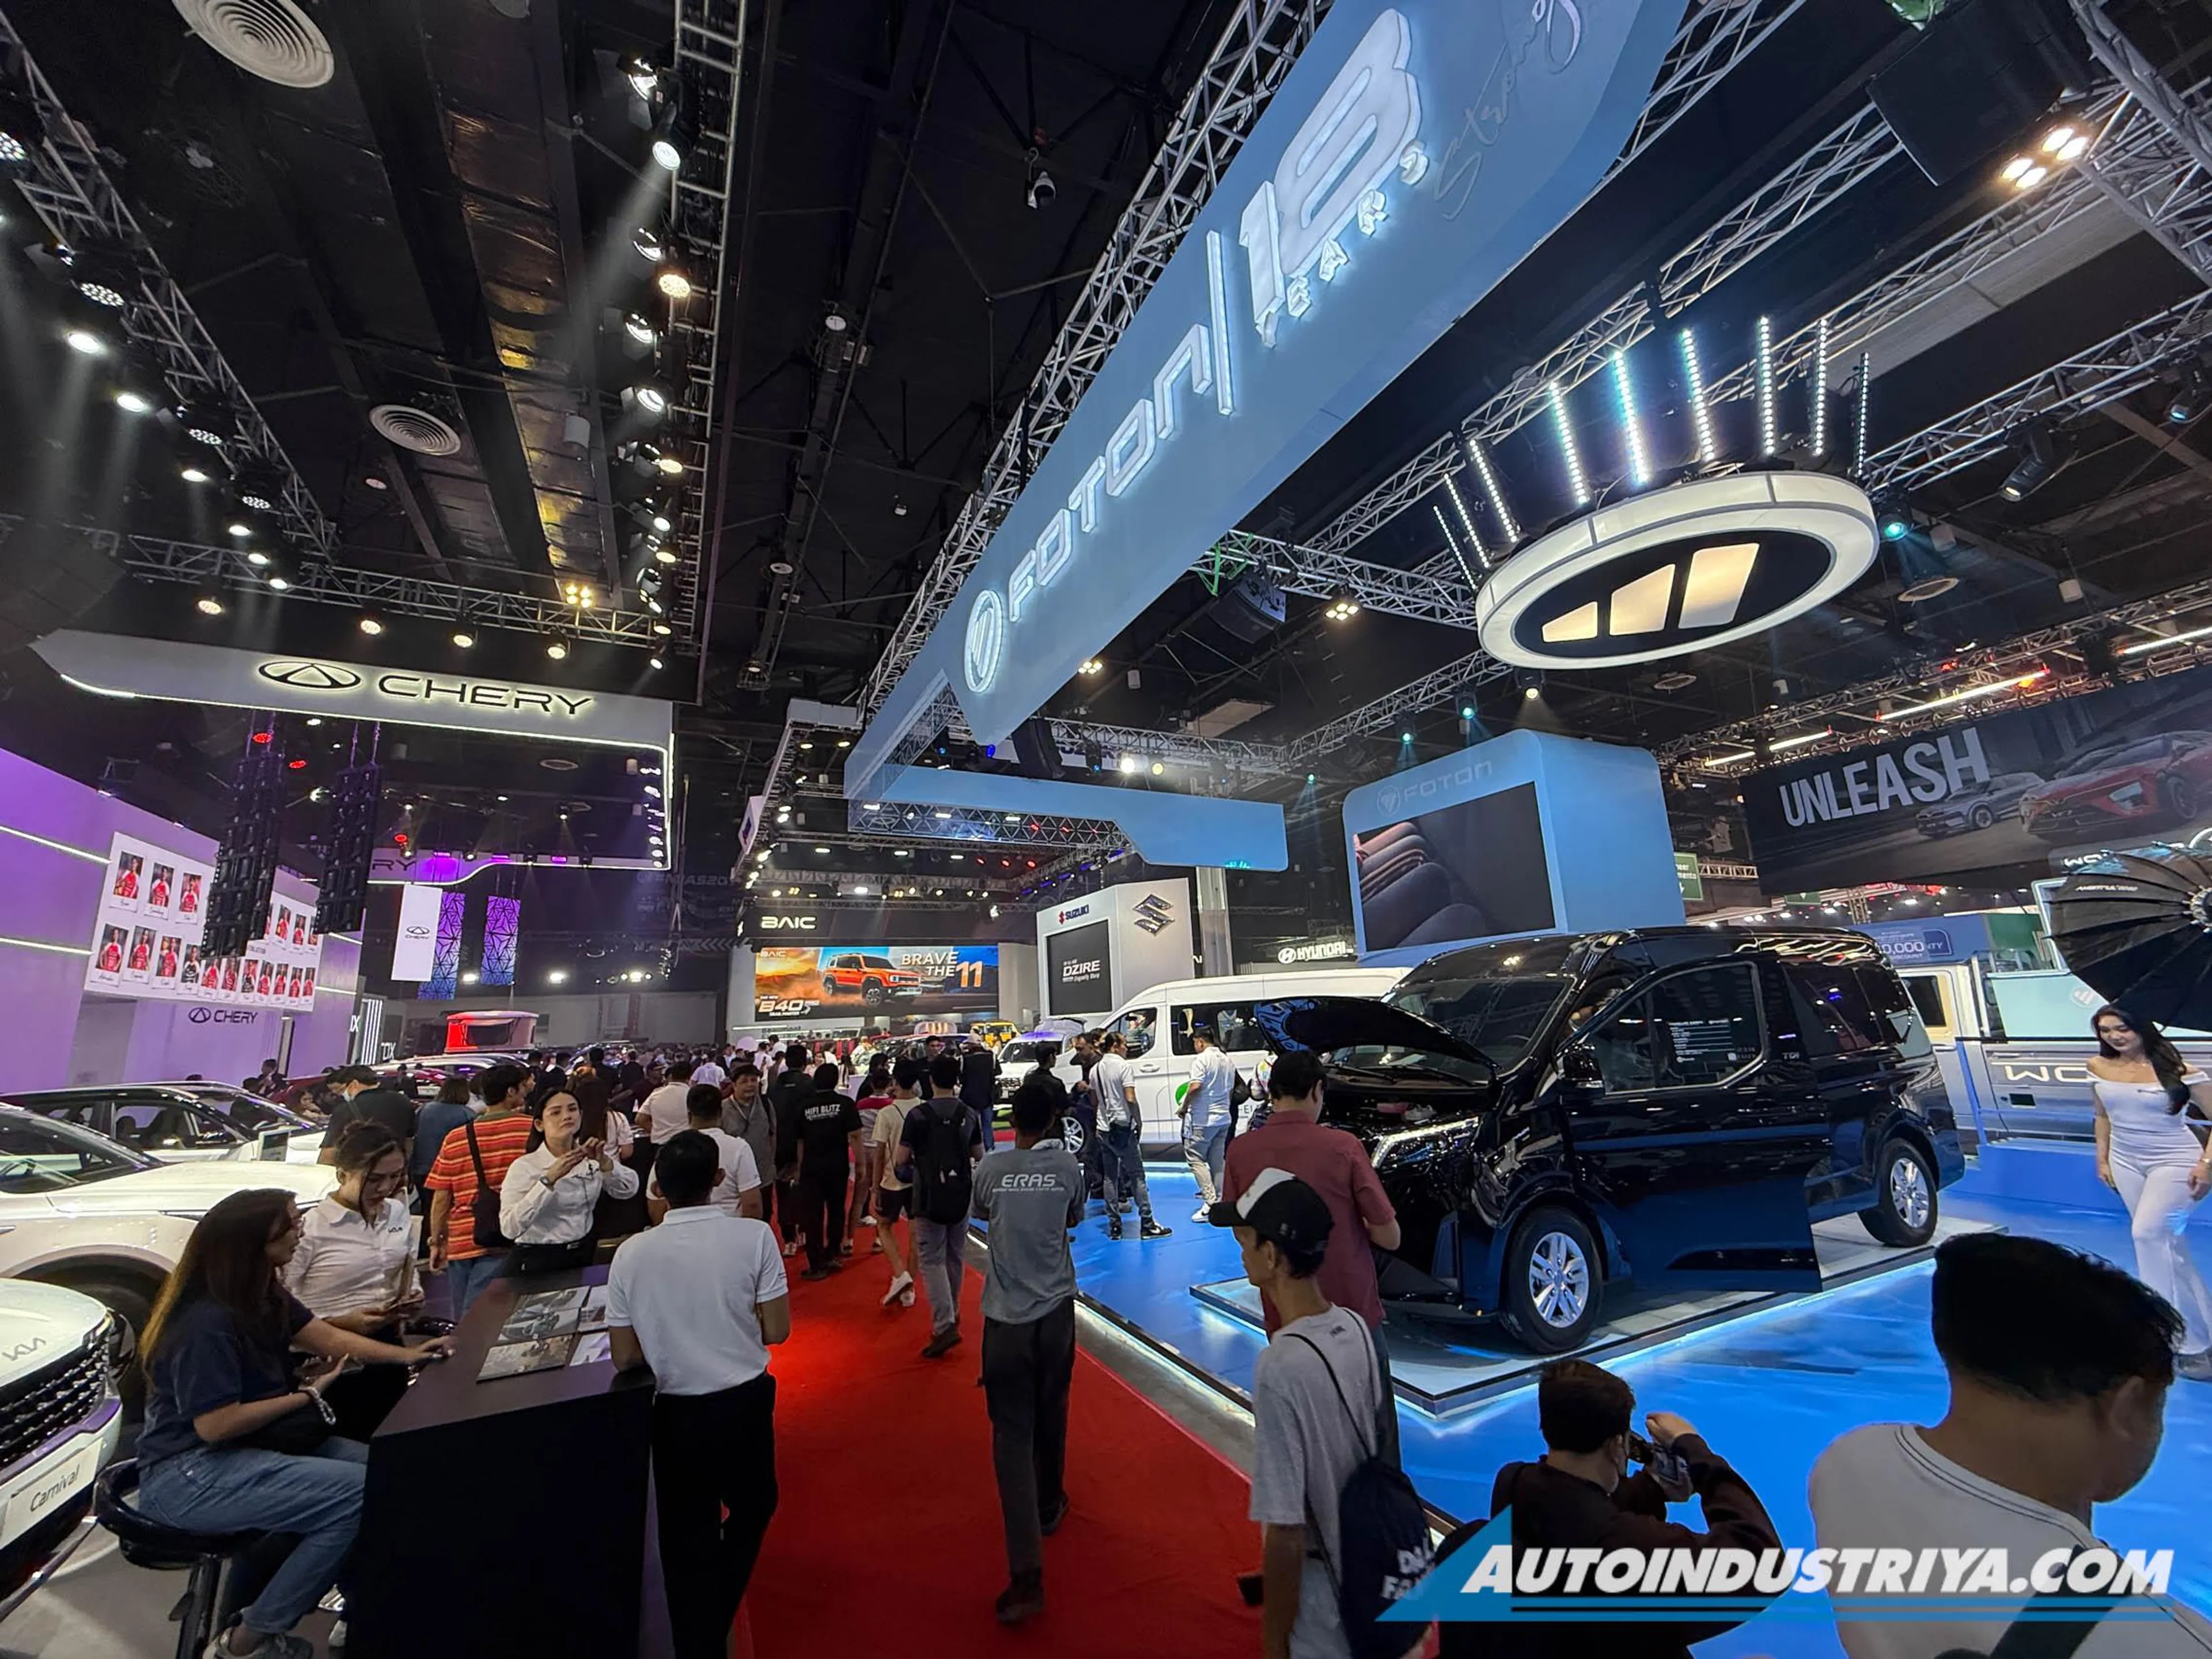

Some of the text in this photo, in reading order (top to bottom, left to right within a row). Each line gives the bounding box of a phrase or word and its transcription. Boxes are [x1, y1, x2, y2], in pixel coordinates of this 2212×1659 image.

[1255, 139, 1429, 348] YEARS
[1009, 8, 1422, 623] FOTON 18
[378, 675, 593, 715] CHERY
[1404, 760, 1493, 802] FOTON
[1779, 727, 1990, 827] UNLEASH
[760, 915, 816, 929] BAIC
[1065, 904, 1089, 920] SUZUKI
[901, 951, 959, 965] BRAVE
[1296, 941, 1348, 961] HYUNDAI
[926, 960, 983, 988] THE 11
[1063, 960, 1101, 977] DZIRE
[758, 999, 804, 1013] B40
[213, 1009, 259, 1024] CHERY
[820, 1104, 840, 1113] BLITZ
[1001, 1173, 1056, 1187] ERAS
[2, 1336, 47, 1361] KIA
[29, 1464, 80, 1513] Carnival
